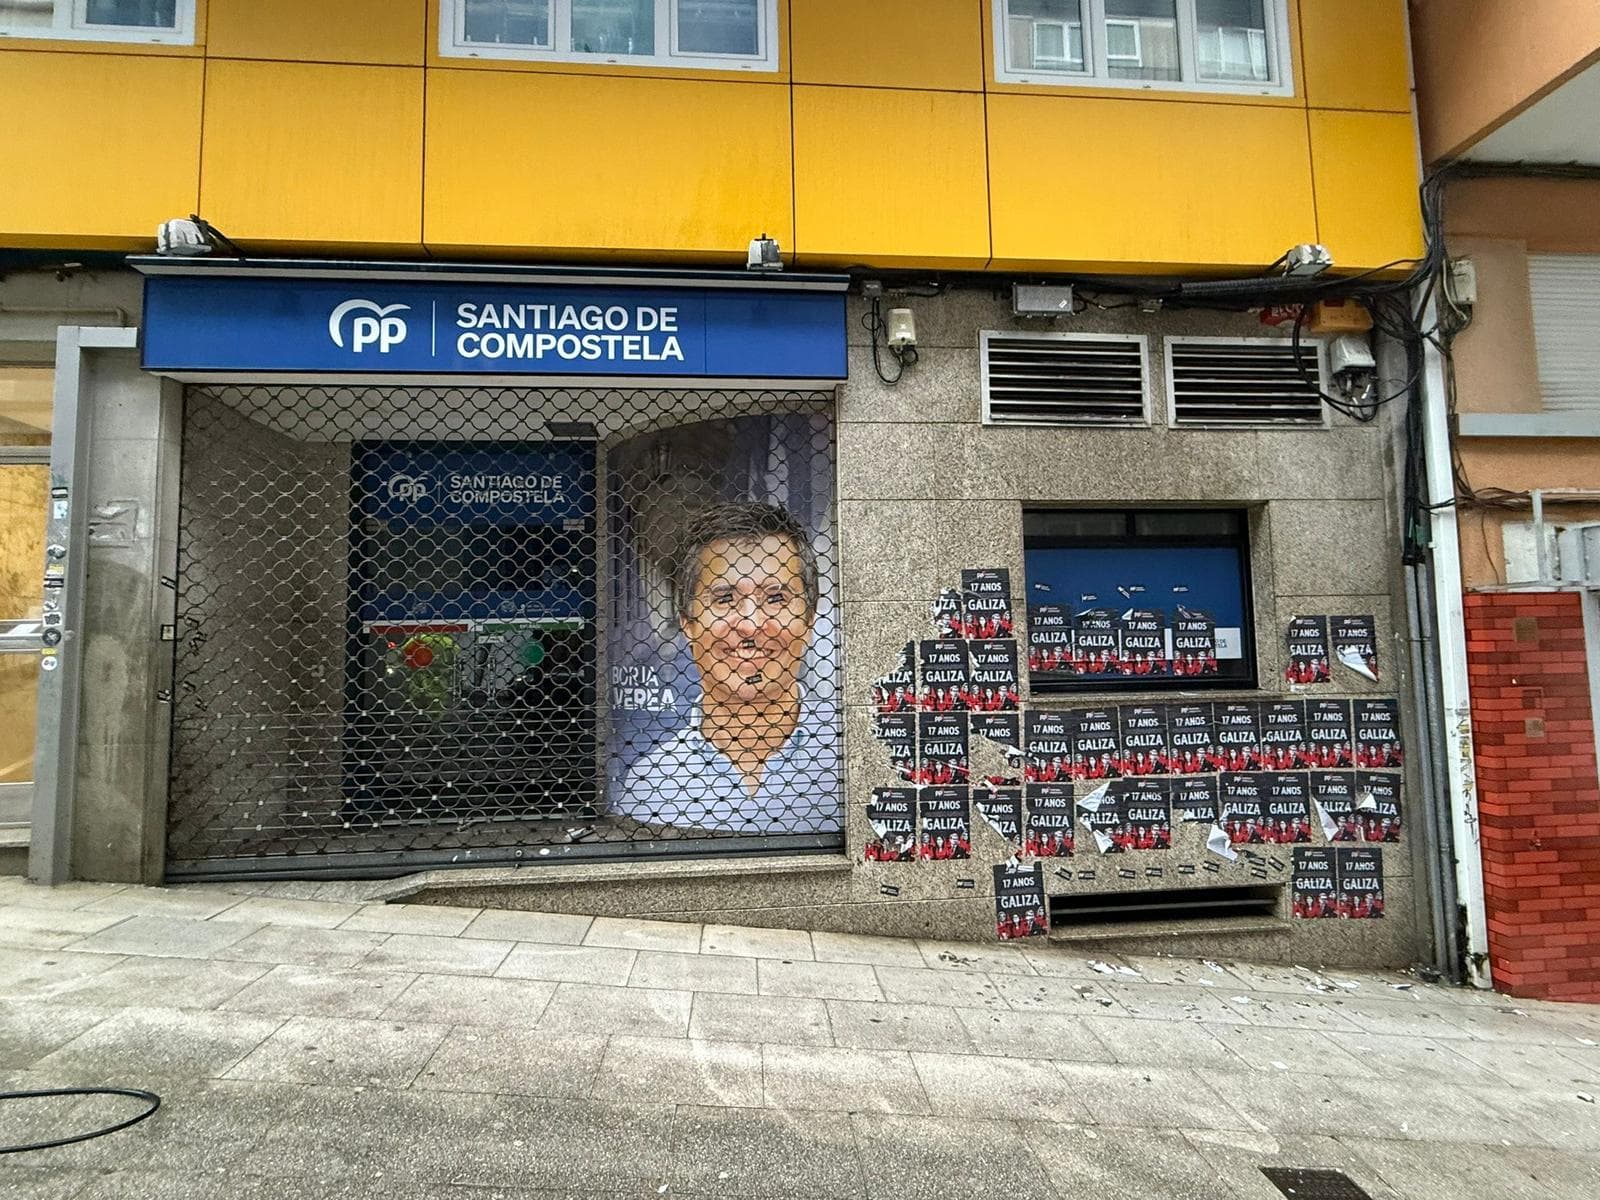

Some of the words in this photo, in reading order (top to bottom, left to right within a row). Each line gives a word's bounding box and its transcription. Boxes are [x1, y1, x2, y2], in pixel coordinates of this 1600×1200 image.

[456, 304, 628, 331] SANTIAGO
[637, 307, 677, 332] DE
[456, 332, 684, 360] COMPOSTELA
[451, 476, 536, 488] SANTIAGO
[541, 476, 561, 488] DE
[451, 490, 564, 503] COMPOSTELA
[971, 583, 978, 591] 17
[980, 582, 1002, 591] ANOS
[968, 599, 1006, 610] GALIZA
[1034, 617, 1042, 625] 17
[1043, 617, 1063, 625] ANOS
[1128, 622, 1136, 630] 17
[1137, 621, 1157, 630] ANOS
[1178, 622, 1186, 630] 17
[1187, 622, 1207, 630] ANOS
[1031, 632, 1068, 644] GALIZA
[1299, 629, 1320, 637] ANOS
[1339, 629, 1346, 637] 17
[1347, 629, 1368, 637] ANOS
[1079, 636, 1115, 647] GALIZA
[1125, 637, 1160, 648] GALIZA
[1176, 637, 1211, 648] GALIZA
[939, 654, 960, 662] ANOS
[926, 671, 965, 682] GALIZA
[975, 671, 1013, 682] GALIZA
[1175, 718, 1183, 726] 17
[1184, 717, 1206, 726] ANOS
[1222, 716, 1230, 724] 17
[1231, 716, 1252, 724] ANOS
[1268, 715, 1276, 723] 17
[1277, 714, 1298, 723] ANOS
[1314, 713, 1322, 722] 17
[1322, 712, 1343, 721] ANOS
[1361, 713, 1369, 722] 17
[1370, 712, 1391, 721] ANOS
[1080, 723, 1088, 731] 17
[1089, 722, 1111, 731] ANOS
[1128, 719, 1136, 728] 17
[1137, 718, 1159, 727] ANOS
[885, 728, 907, 736] ANOS
[928, 727, 936, 735] 17
[938, 726, 960, 735] ANOS
[989, 728, 1011, 736] ANOS
[1032, 724, 1041, 733] 17
[1042, 725, 1064, 734] ANOS
[1311, 728, 1347, 740] GALIZA
[1359, 728, 1396, 740] GALIZA
[1126, 734, 1163, 747] GALIZA
[1174, 733, 1210, 745] GALIZA
[1219, 731, 1256, 743] GALIZA
[1266, 730, 1302, 742] GALIZA
[925, 743, 964, 755] GALIZA
[1029, 742, 1068, 753] GALIZA
[1078, 738, 1116, 750] GALIZA
[1227, 787, 1236, 795] 17
[1237, 786, 1258, 795] ANOS
[1272, 787, 1280, 795] 17
[1281, 786, 1302, 795] ANOS
[1319, 785, 1326, 794] 17
[1327, 785, 1347, 794] ANOS
[1372, 786, 1393, 795] ANOS
[1132, 792, 1140, 800] 17
[1141, 792, 1162, 801] ANOS
[1188, 791, 1209, 800] ANOS
[875, 802, 884, 811] 17
[885, 803, 908, 811] ANOS
[929, 801, 937, 810] 17
[938, 801, 960, 809] ANOS
[991, 804, 1013, 813] ANOS
[1034, 799, 1042, 808] 17
[1044, 799, 1066, 808] ANOS
[1269, 803, 1305, 814] GALIZA
[1128, 809, 1166, 820] GALIZA
[927, 818, 964, 830] GALIZA
[1031, 815, 1069, 827] GALIZA
[1299, 862, 1307, 870] 17
[1308, 861, 1328, 870] ANOS
[1346, 862, 1353, 870] 17
[1355, 862, 1375, 870] ANOS
[1002, 879, 1011, 888] 17
[1012, 877, 1035, 887] ANOS
[1296, 878, 1332, 890] GALIZA
[1343, 878, 1379, 890] GALIZA
[1000, 894, 1040, 908] GALIZA
